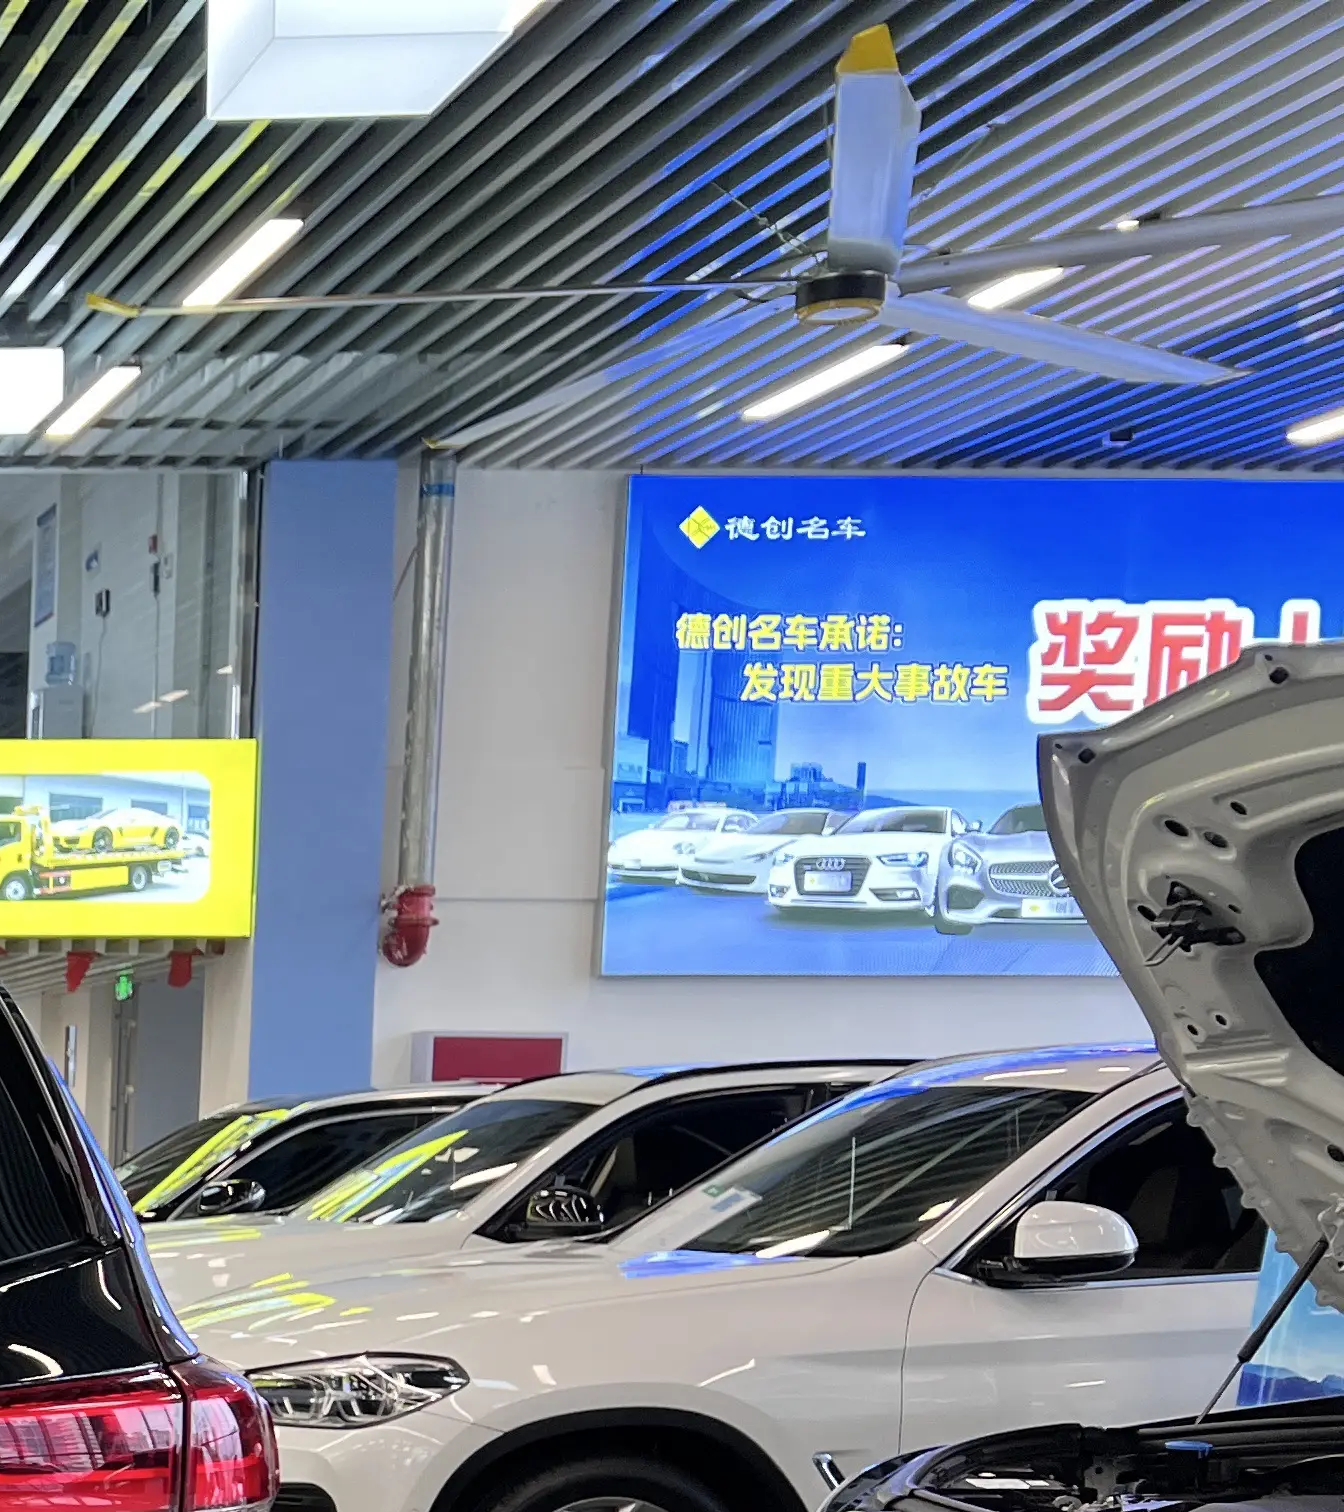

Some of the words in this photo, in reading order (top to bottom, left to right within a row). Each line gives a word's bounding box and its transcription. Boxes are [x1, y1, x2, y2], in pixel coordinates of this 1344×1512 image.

[724, 515, 866, 541] 德创名车
[1038, 610, 1309, 712] 奖励
[740, 662, 1008, 702] 发现重大事故车
